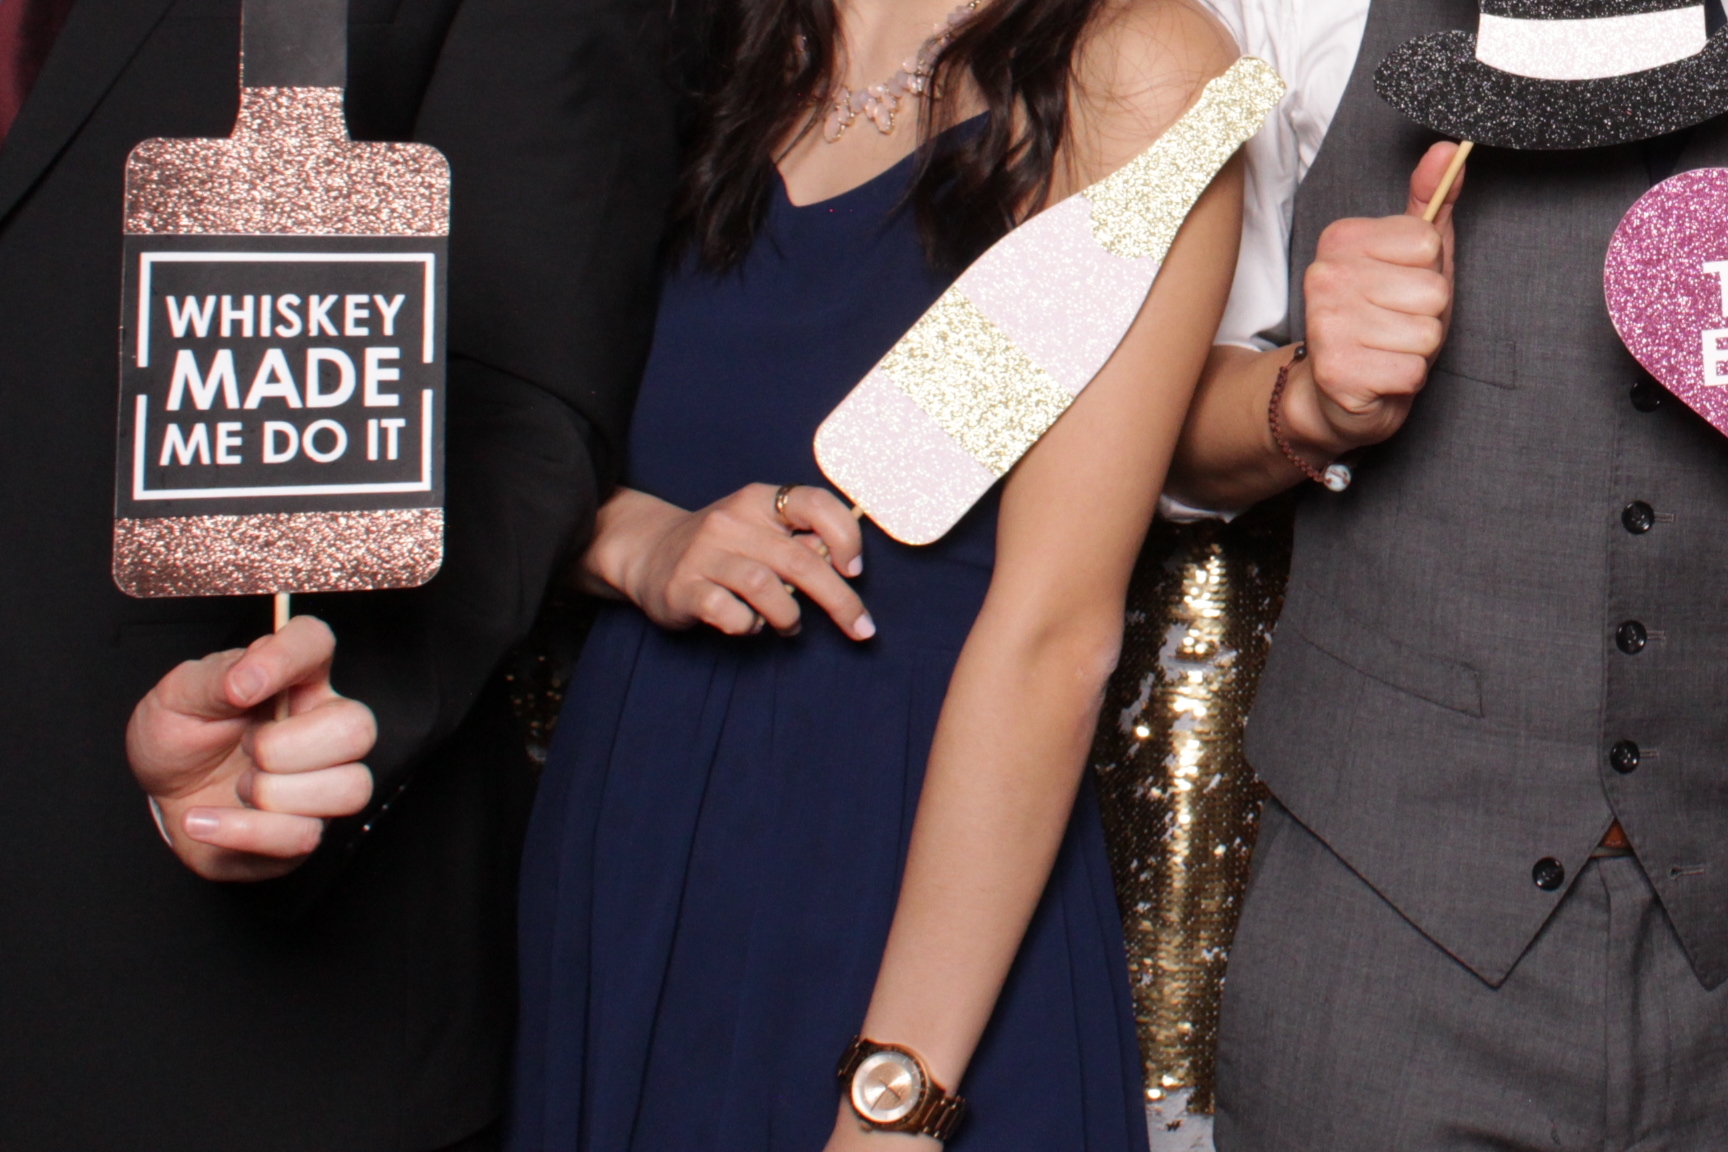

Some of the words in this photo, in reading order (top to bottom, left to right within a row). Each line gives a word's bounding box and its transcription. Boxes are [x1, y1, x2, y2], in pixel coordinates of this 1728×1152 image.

[166, 294, 405, 338] WHISKEY
[165, 347, 400, 411] MADE
[159, 421, 242, 466] ME
[262, 419, 347, 464] DO
[366, 418, 406, 461] IT
